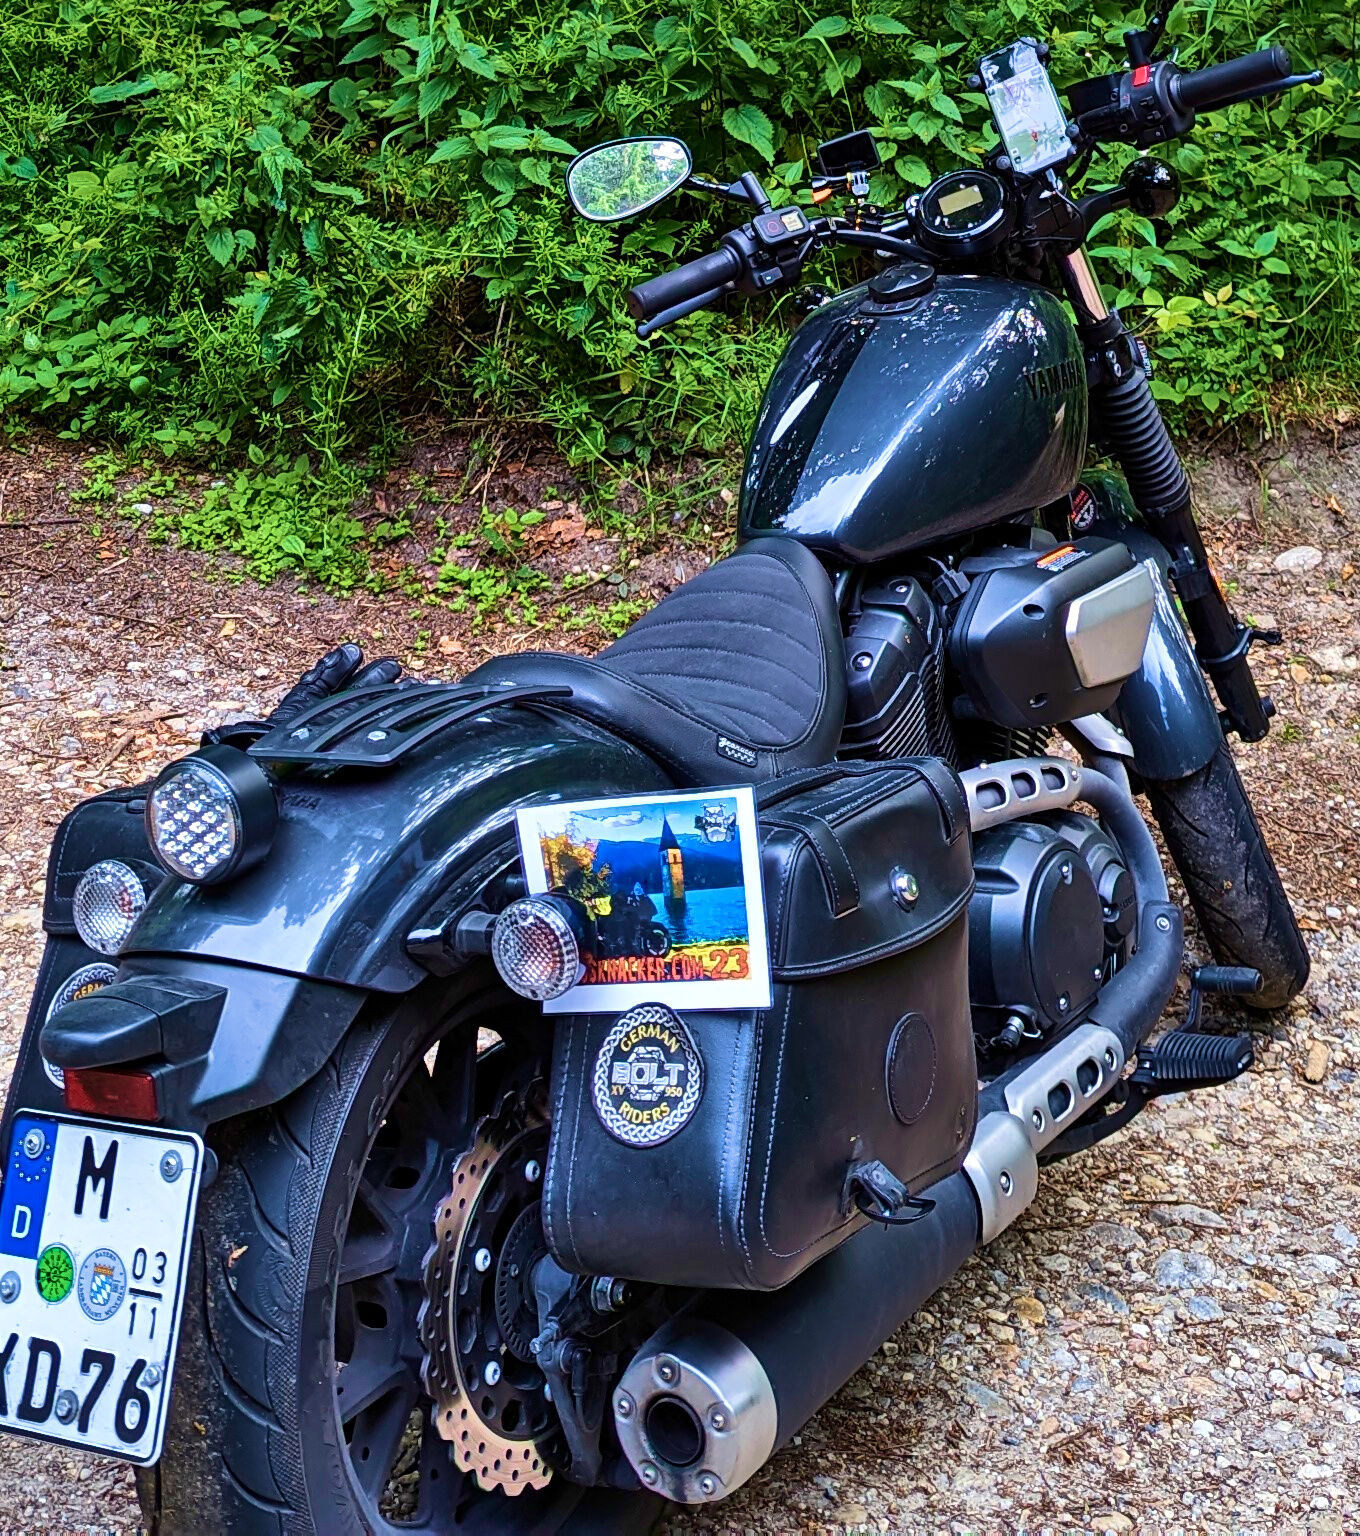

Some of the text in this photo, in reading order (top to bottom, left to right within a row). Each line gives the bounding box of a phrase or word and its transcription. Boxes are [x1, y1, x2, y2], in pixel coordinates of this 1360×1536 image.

[1023, 359, 1081, 401] YAMAHA
[709, 948, 749, 979] 23
[620, 1024, 680, 1053] GERMAN
[612, 1062, 684, 1085] BOLT
[610, 1084, 683, 1097] XV 950
[618, 1101, 671, 1124] RIDERS
[74, 1135, 119, 1220] M
[11, 1205, 32, 1239] D
[132, 1247, 167, 1285] 03
[128, 1302, 158, 1340] 11
